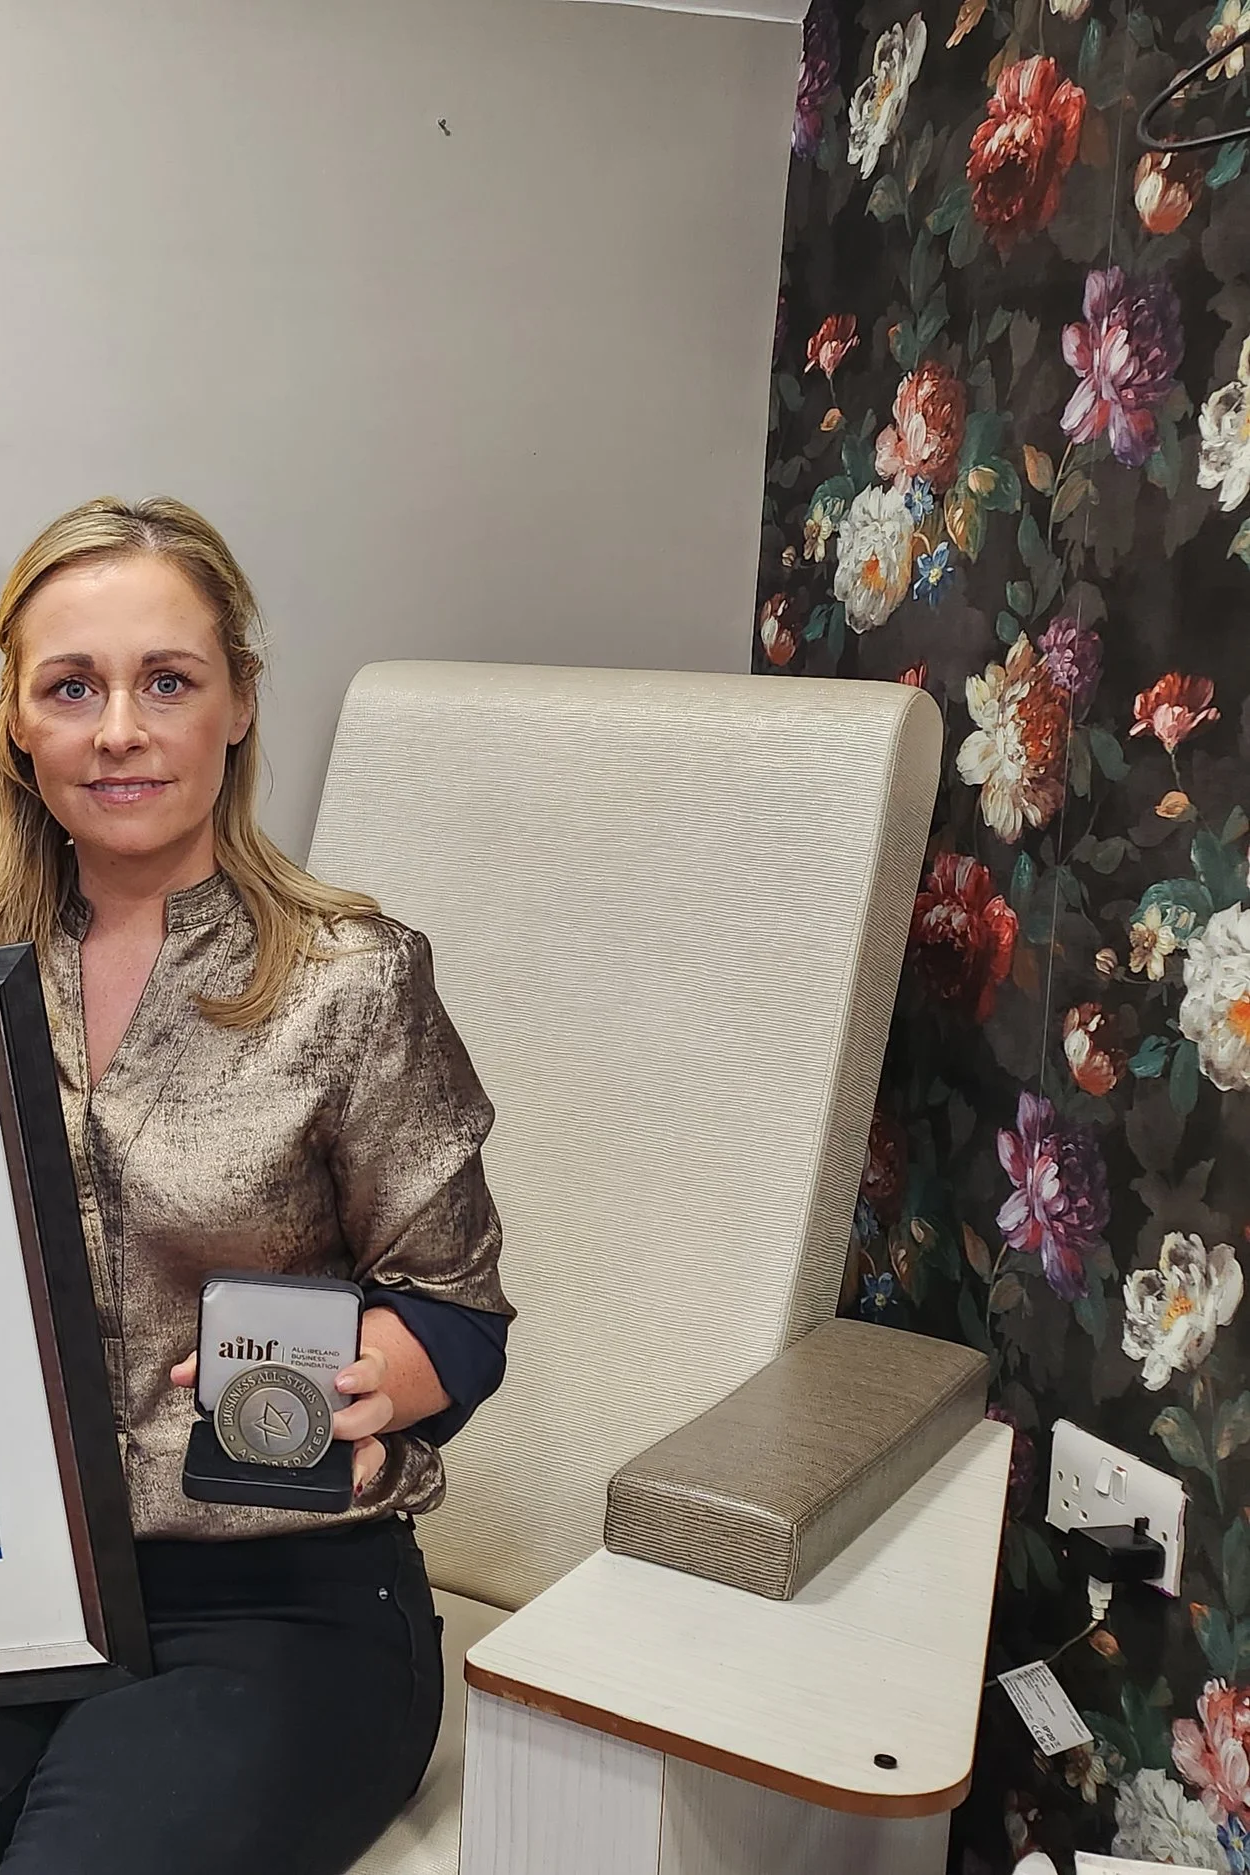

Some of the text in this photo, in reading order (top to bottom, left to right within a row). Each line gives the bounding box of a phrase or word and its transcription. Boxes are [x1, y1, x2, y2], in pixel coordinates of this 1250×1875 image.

[218, 1336, 279, 1361] aibf
[291, 1353, 327, 1362] BUSINESS
[290, 1360, 339, 1371] FOUNDATION
[223, 1371, 317, 1426] BUSINESS ALL-STARS
